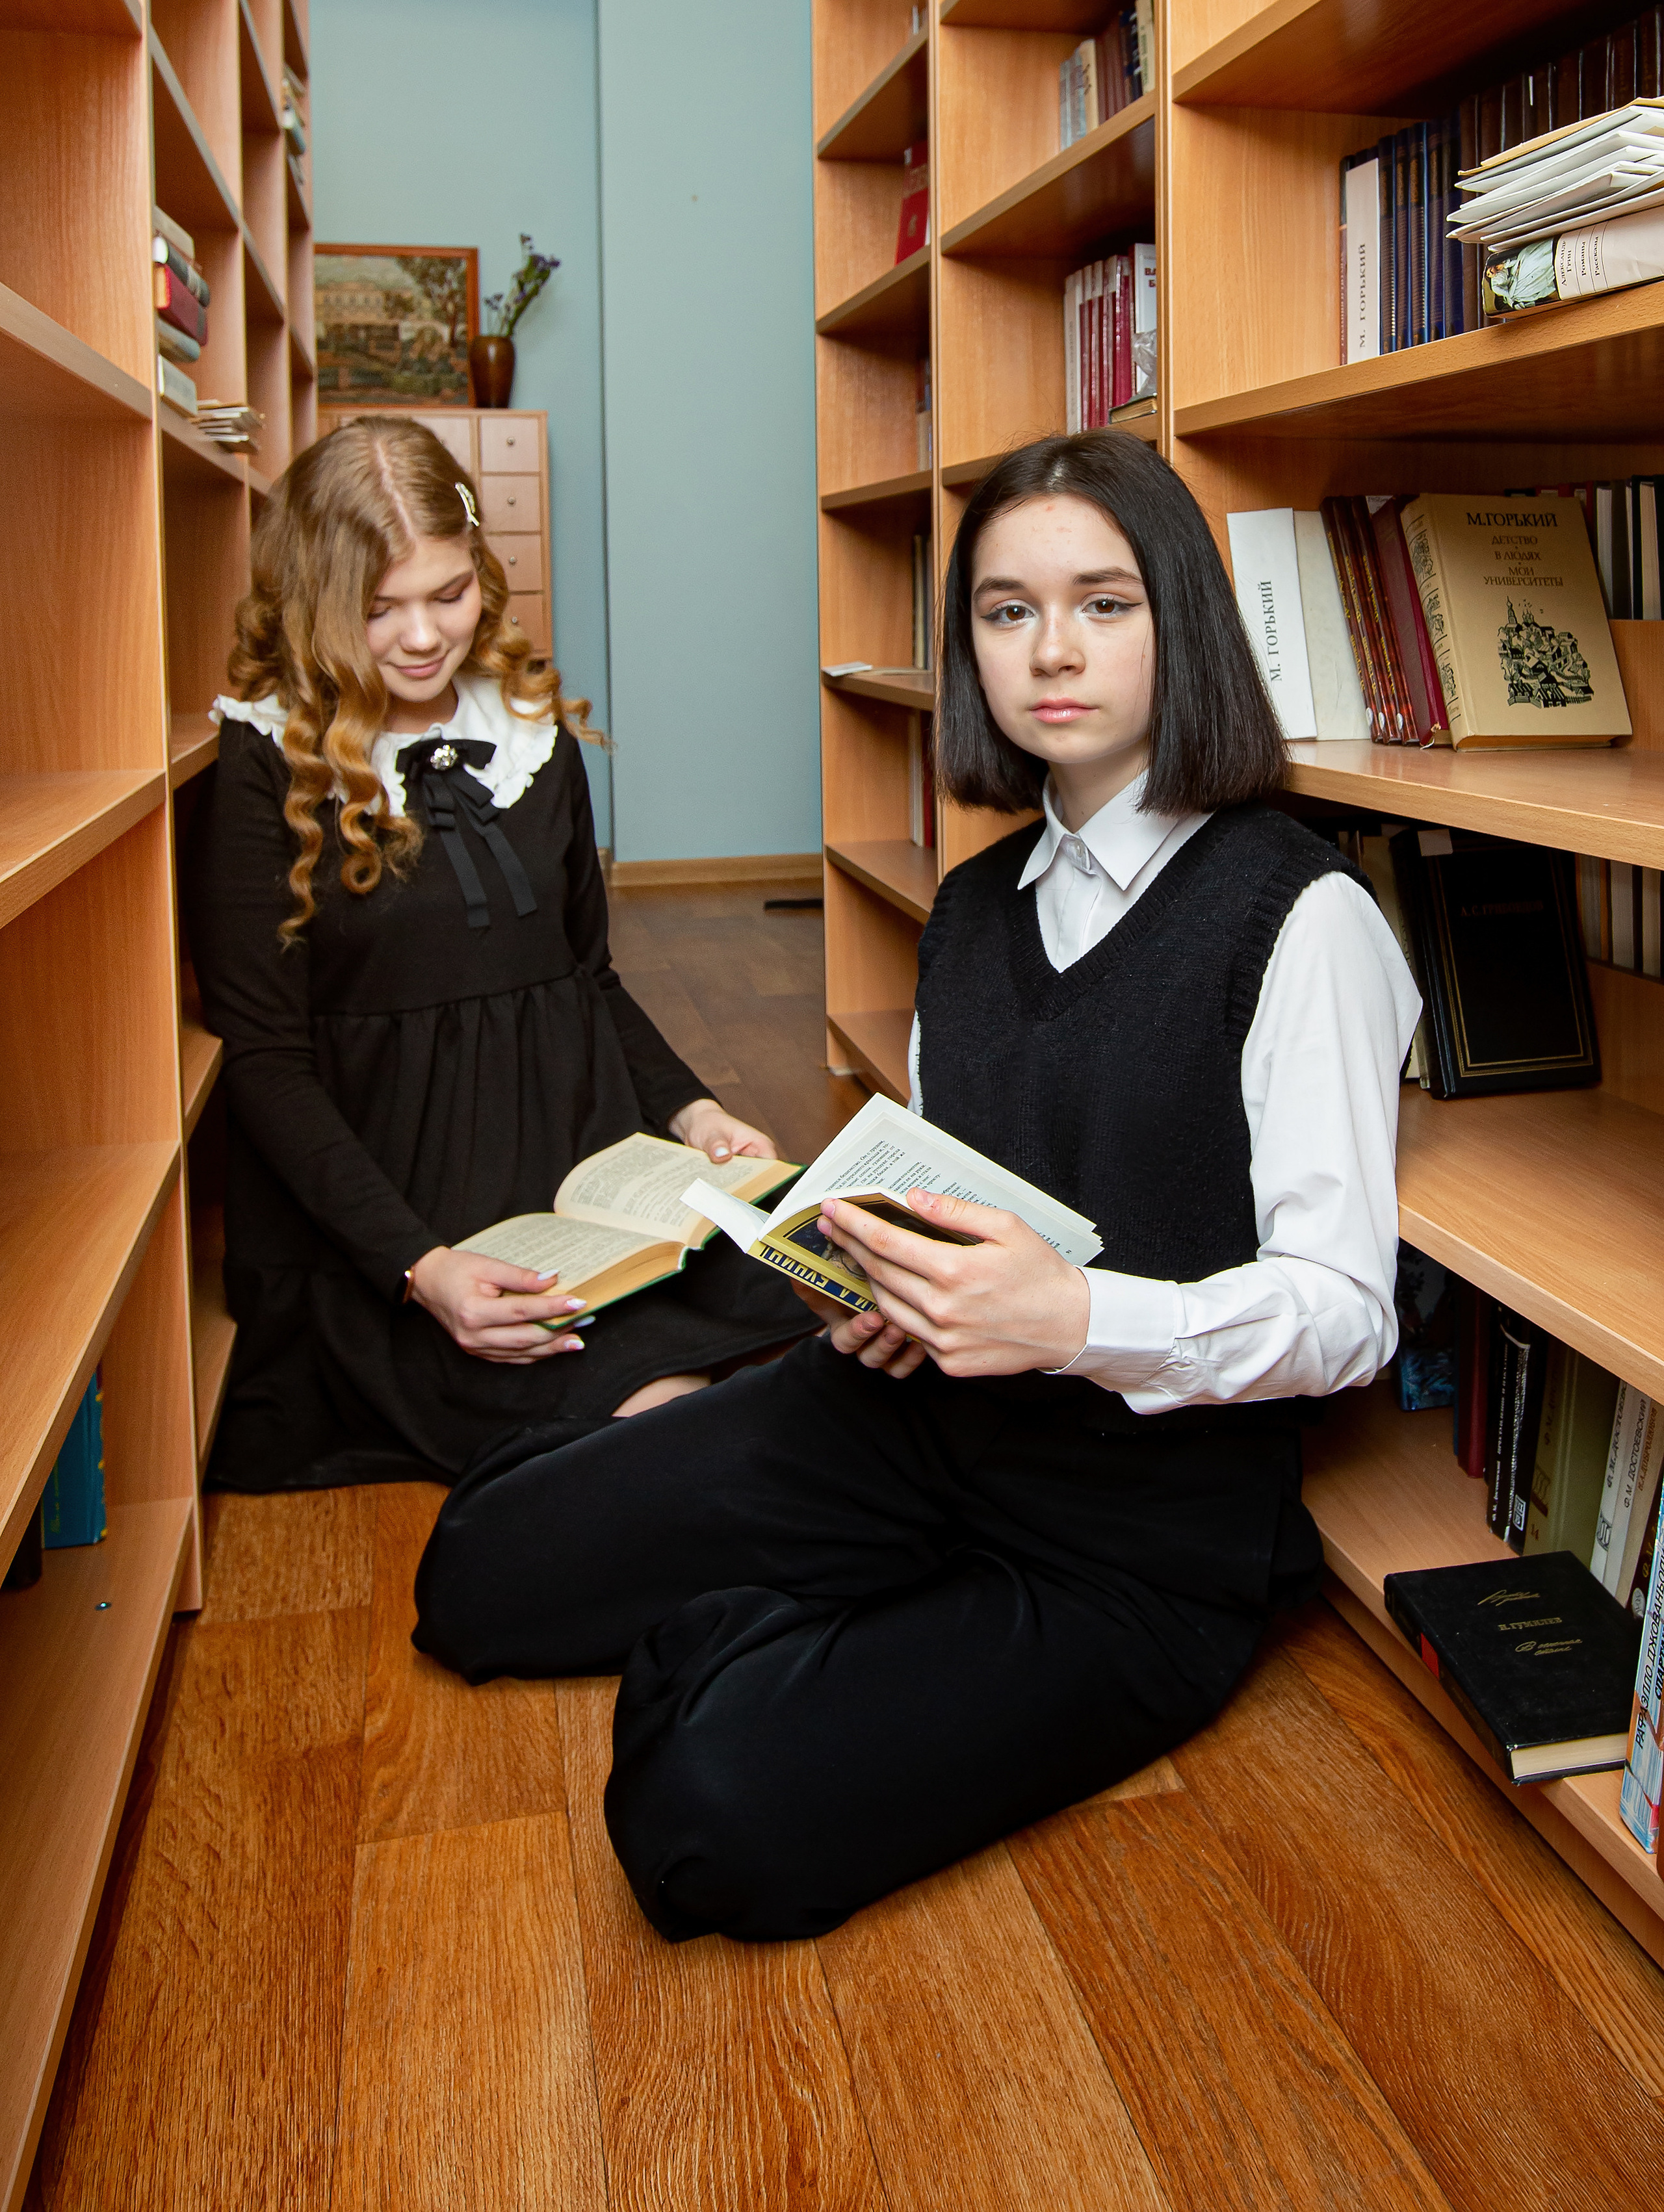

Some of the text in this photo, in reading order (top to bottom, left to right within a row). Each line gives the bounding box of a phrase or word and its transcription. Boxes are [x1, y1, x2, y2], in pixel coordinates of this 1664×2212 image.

[1359, 329, 1366, 348] М.
[1491, 535, 1539, 545] ДЕТСТВО
[1494, 551, 1542, 561] В ЛЮДЯХ
[1508, 567, 1535, 576] МОИ
[1483, 576, 1564, 587] УНИВЕРСИТЕТЫ
[1258, 580, 1282, 682] М. ГОРЬКИЙ
[768, 1250, 830, 1288] БУНИН
[1635, 1664, 1653, 1749] РАФАЭЛЛО
